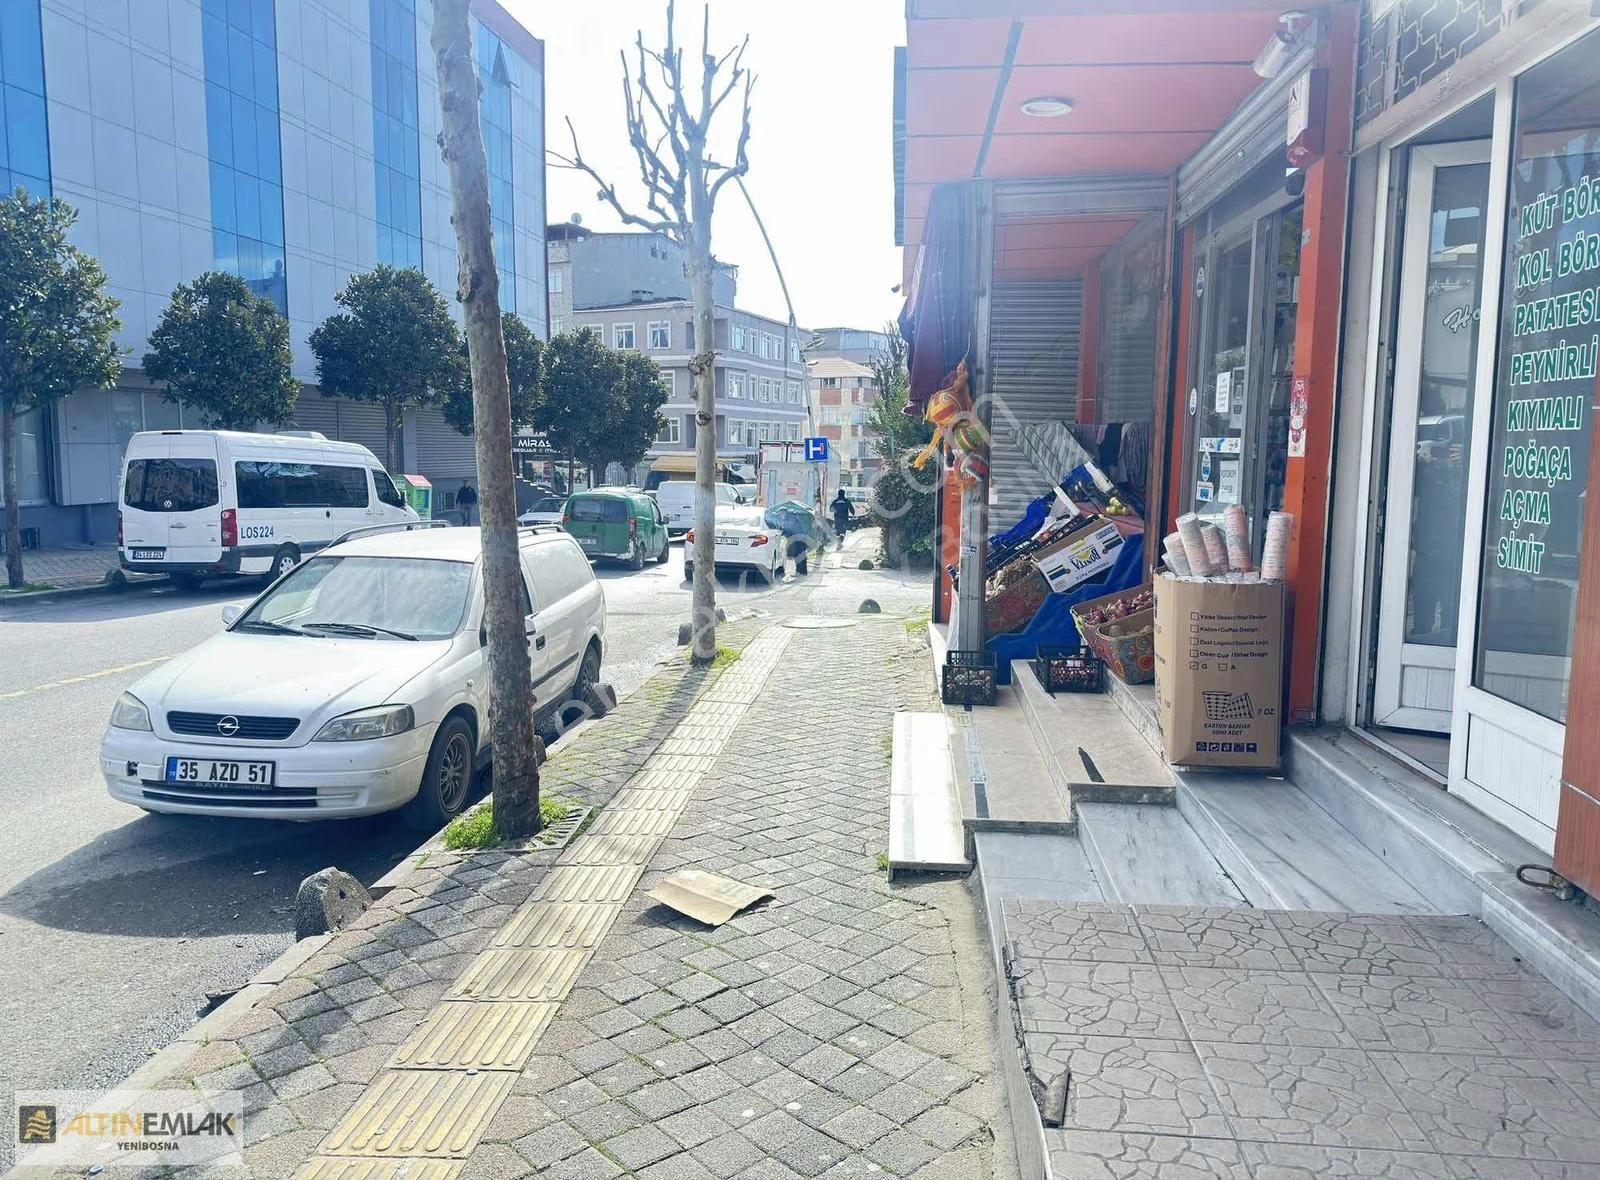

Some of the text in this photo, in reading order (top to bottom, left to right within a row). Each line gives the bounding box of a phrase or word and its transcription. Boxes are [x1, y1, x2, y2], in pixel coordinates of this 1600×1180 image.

[1520, 175, 1600, 238] KÜT BÖR
[1517, 231, 1600, 288] KOL BÖR
[1510, 335, 1599, 386] PEYNİRLİ
[1506, 395, 1584, 431] KIYMALI
[518, 437, 551, 448] MİRAS
[1503, 438, 1572, 488] POĞAÇA
[1500, 489, 1551, 529] AÇMA
[240, 525, 274, 539] LOS224
[1497, 531, 1545, 576] SİMİT
[179, 761, 198, 780] 35
[209, 762, 240, 782] AZD
[248, 764, 267, 783] 51
